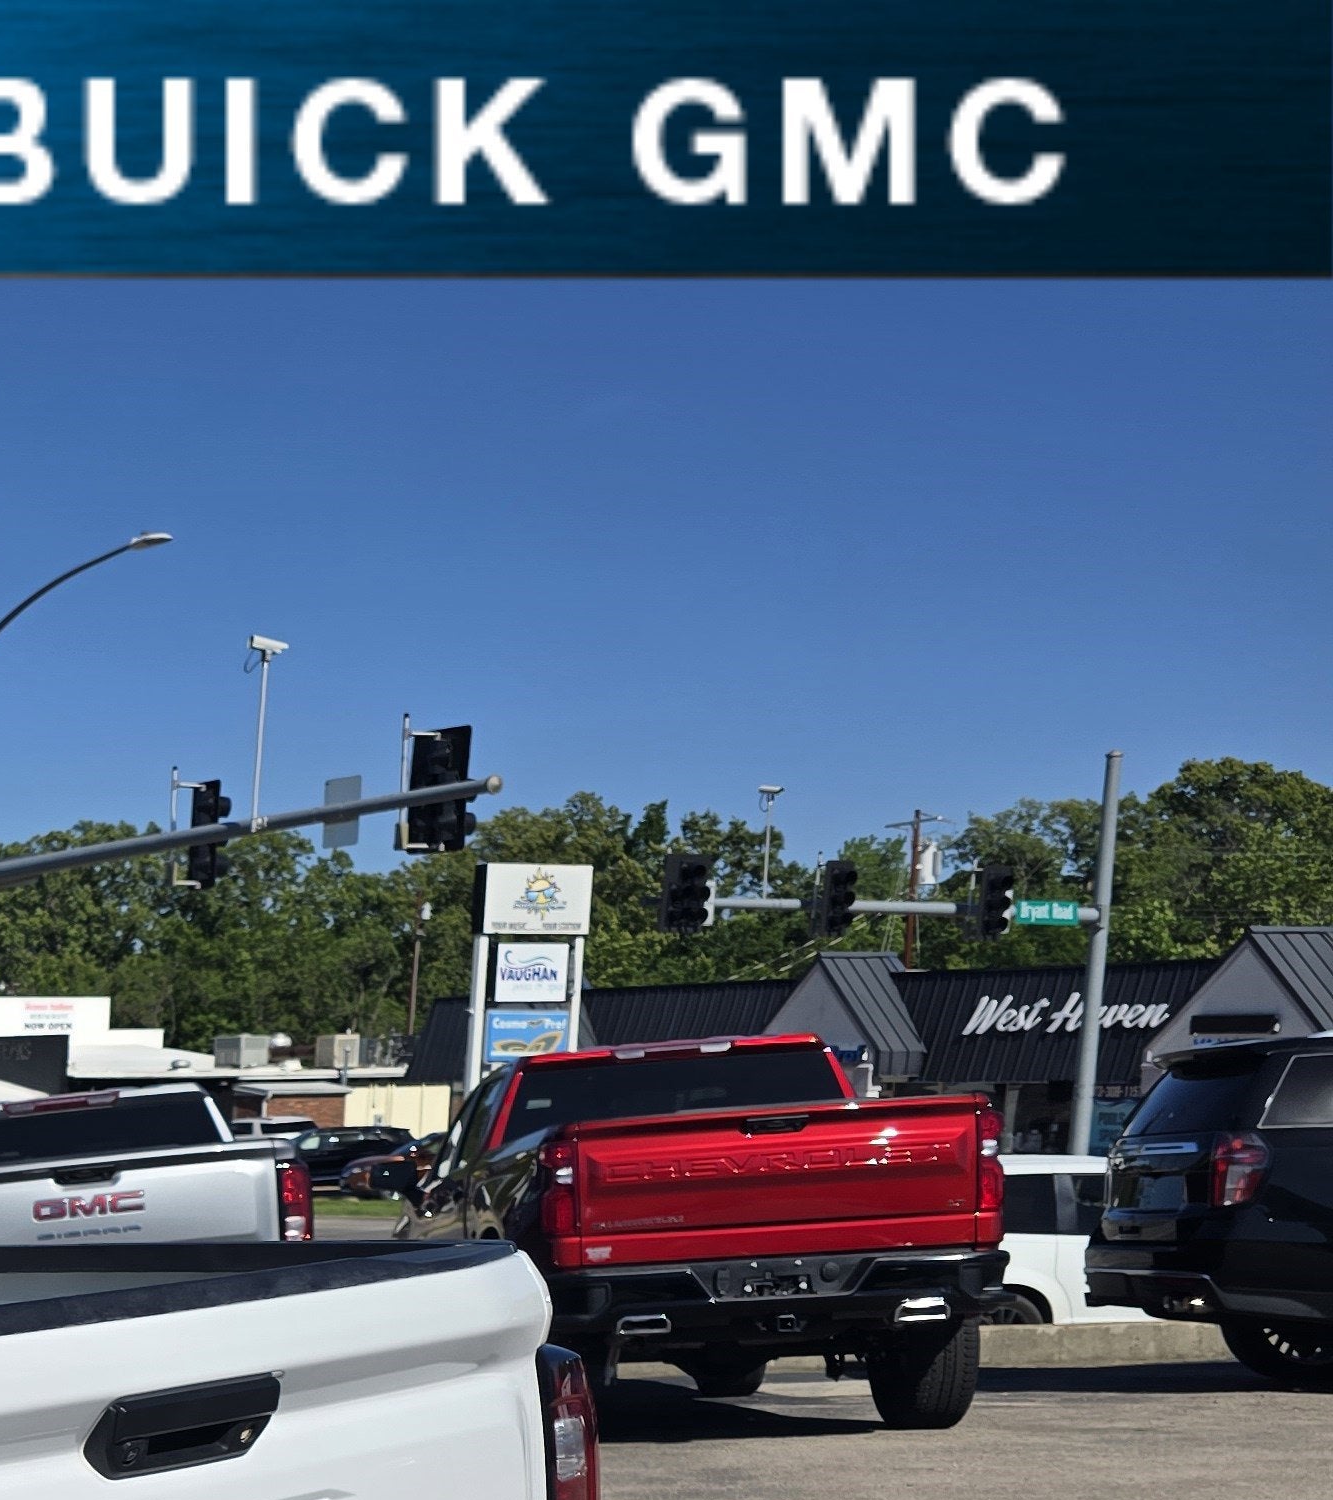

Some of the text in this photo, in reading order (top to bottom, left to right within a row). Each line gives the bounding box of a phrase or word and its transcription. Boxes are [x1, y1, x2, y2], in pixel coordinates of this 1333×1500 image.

[500, 966, 558, 982] VAUGHAN
[961, 991, 1171, 1036] West Hven
[32, 1189, 146, 1222] GMC
